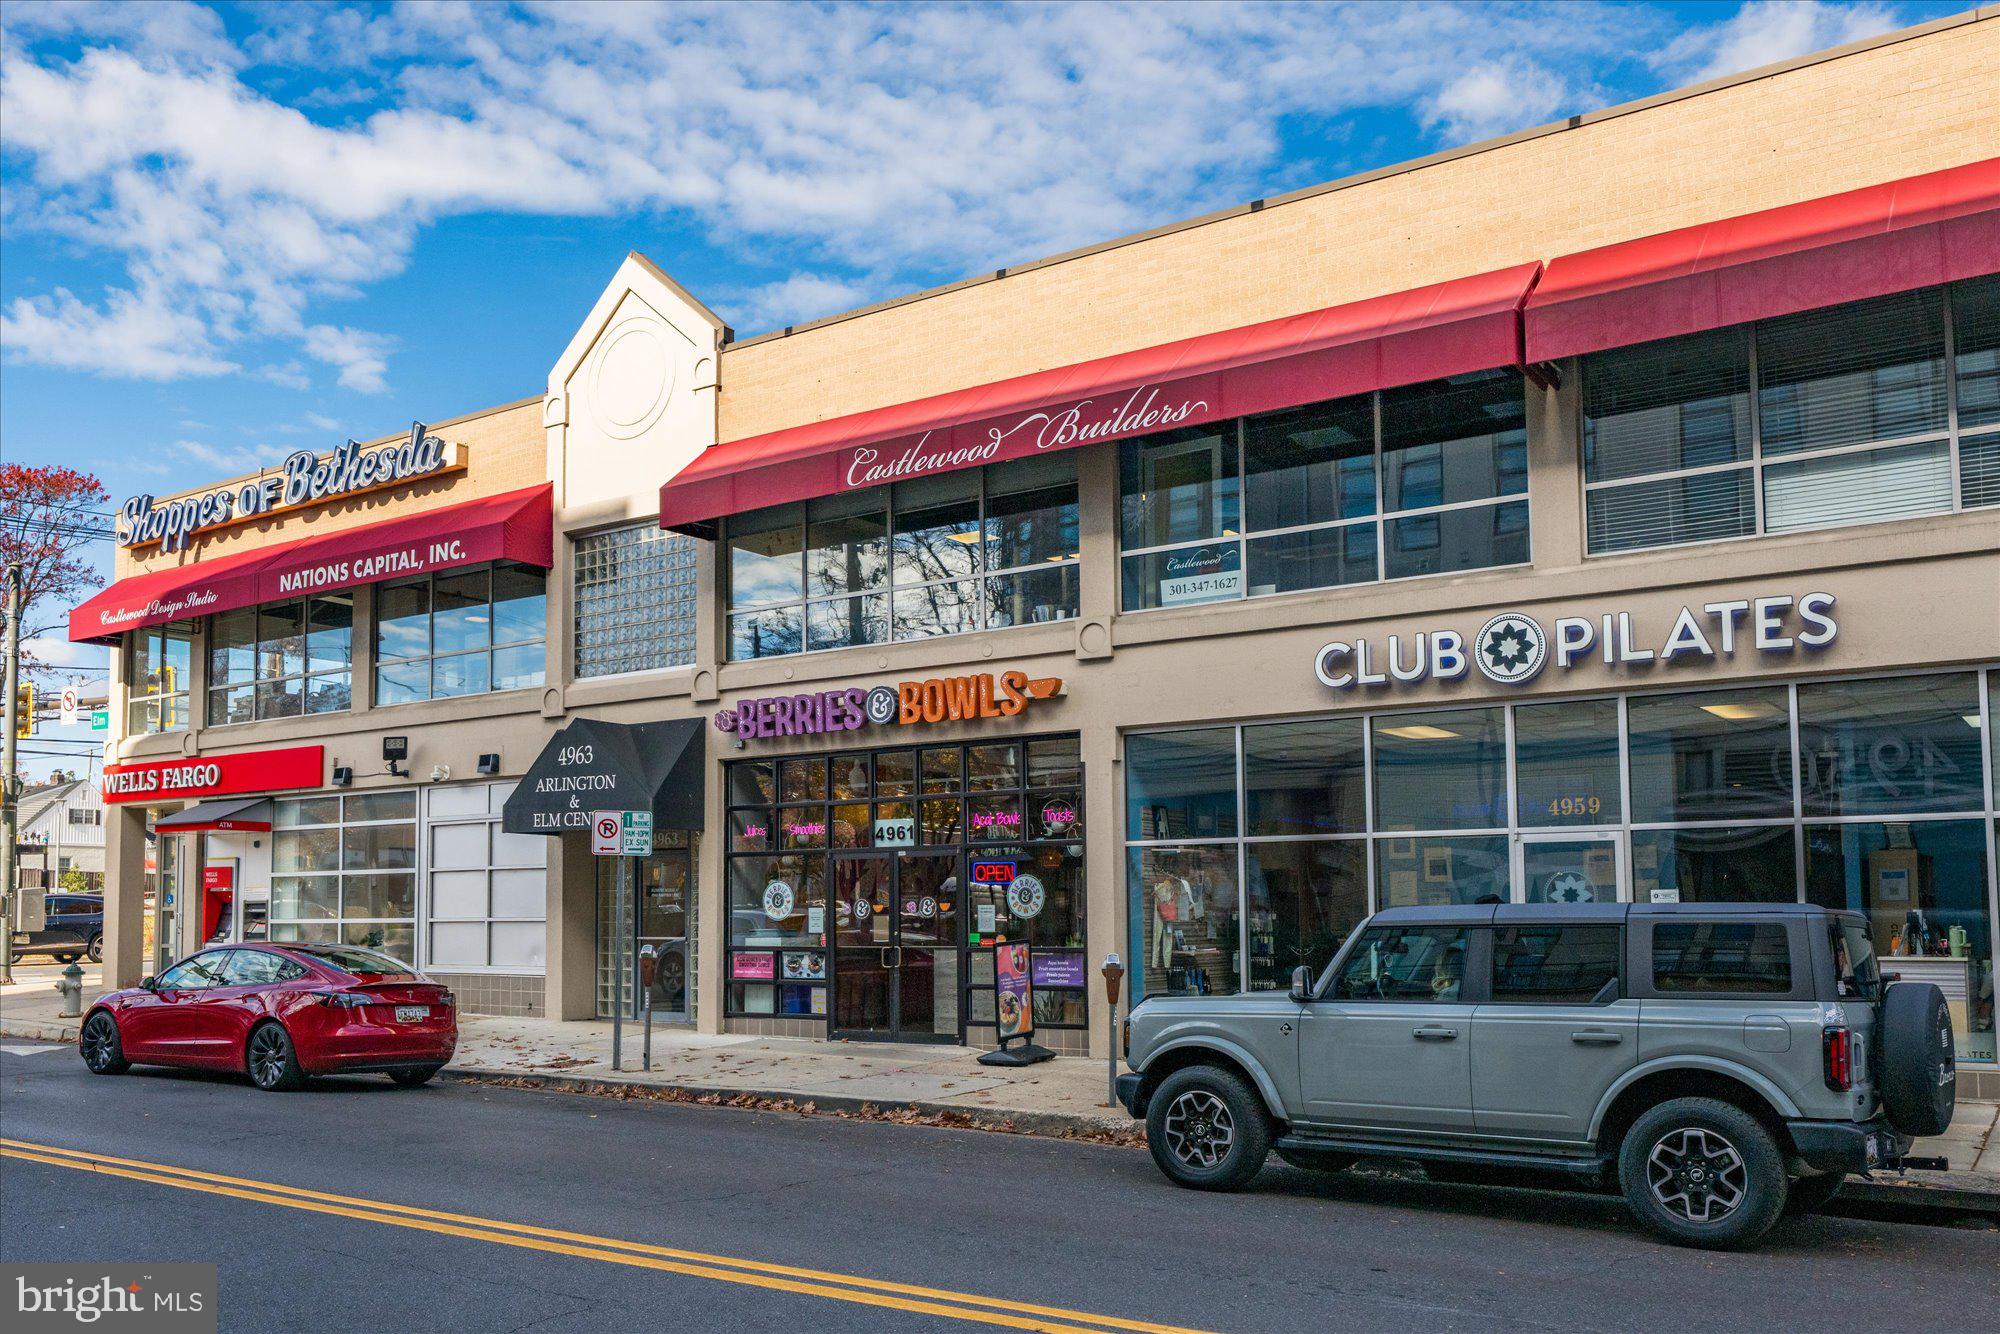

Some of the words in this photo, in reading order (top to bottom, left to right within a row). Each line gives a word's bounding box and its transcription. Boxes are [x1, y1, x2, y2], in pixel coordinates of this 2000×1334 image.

[847, 414, 1048, 486] Castlewood
[1036, 385, 1207, 449] Builders
[117, 493, 233, 552] Shoppes
[284, 420, 446, 506] Bethesda
[279, 562, 349, 593] NATIONS
[353, 552, 424, 579] CAPITAL,
[429, 540, 467, 564] INC.
[1166, 549, 1238, 571] Castlewood
[1169, 577, 1238, 596] 301-347-1627
[99, 603, 150, 626] Castlewood
[150, 598, 185, 617] Design
[184, 589, 219, 607] Studio
[1314, 629, 1468, 689] CLUB
[1555, 592, 1840, 669] PILATES
[737, 687, 868, 739] BERRIES
[871, 691, 889, 722] &
[899, 670, 1028, 725] BOWLS
[93, 716, 105, 726] Elm
[558, 745, 594, 766] 4963
[103, 769, 159, 794] WELLS
[162, 763, 221, 789] FARGO
[535, 774, 617, 793] ARLINGTON
[569, 794, 580, 808] &
[1548, 796, 1601, 816] 4959
[533, 812, 561, 828] ELM
[564, 811, 593, 827] CEN
[1042, 807, 1075, 822] Toasts
[218, 821, 233, 829] ATM
[744, 824, 766, 838] Juices
[788, 823, 826, 836] Smoothies
[875, 824, 915, 841] 4961
[625, 838, 634, 846] EX
[636, 838, 649, 847] SUN
[975, 865, 1015, 882] OPEN
[1011, 878, 1040, 895] BERRIES
[1013, 900, 1039, 914] BOWLS
